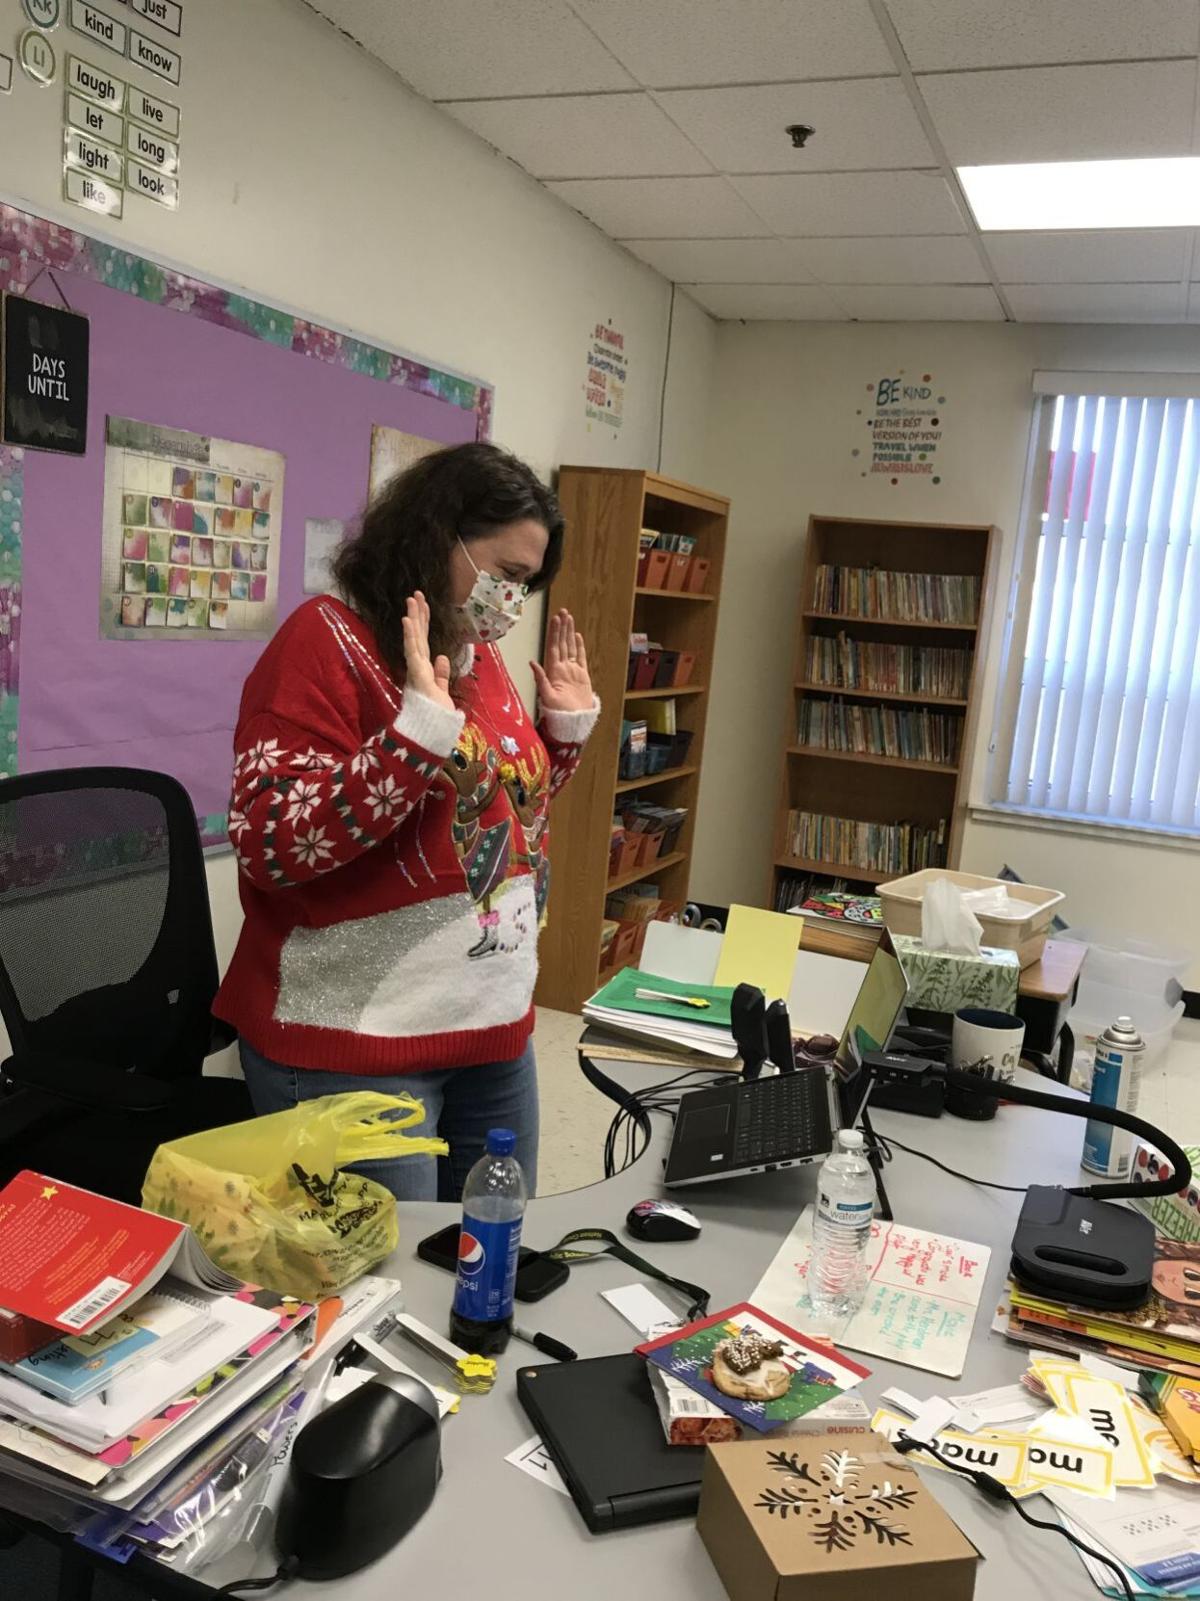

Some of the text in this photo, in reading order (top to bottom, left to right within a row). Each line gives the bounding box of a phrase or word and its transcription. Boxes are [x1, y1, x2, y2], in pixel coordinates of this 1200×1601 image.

[142, 0, 168, 19] just
[85, 10, 114, 40] kind
[138, 40, 172, 72] know
[77, 65, 115, 100] laugh
[86, 107, 103, 130] let
[142, 98, 163, 122] live
[79, 142, 109, 169] light
[138, 133, 165, 163] long
[83, 180, 106, 205] like
[138, 169, 165, 195] look
[32, 353, 66, 379] DAYS
[28, 374, 70, 402] UNTIL
[876, 378, 932, 406] BE KIND
[826, 1425, 866, 1434] cuisine
